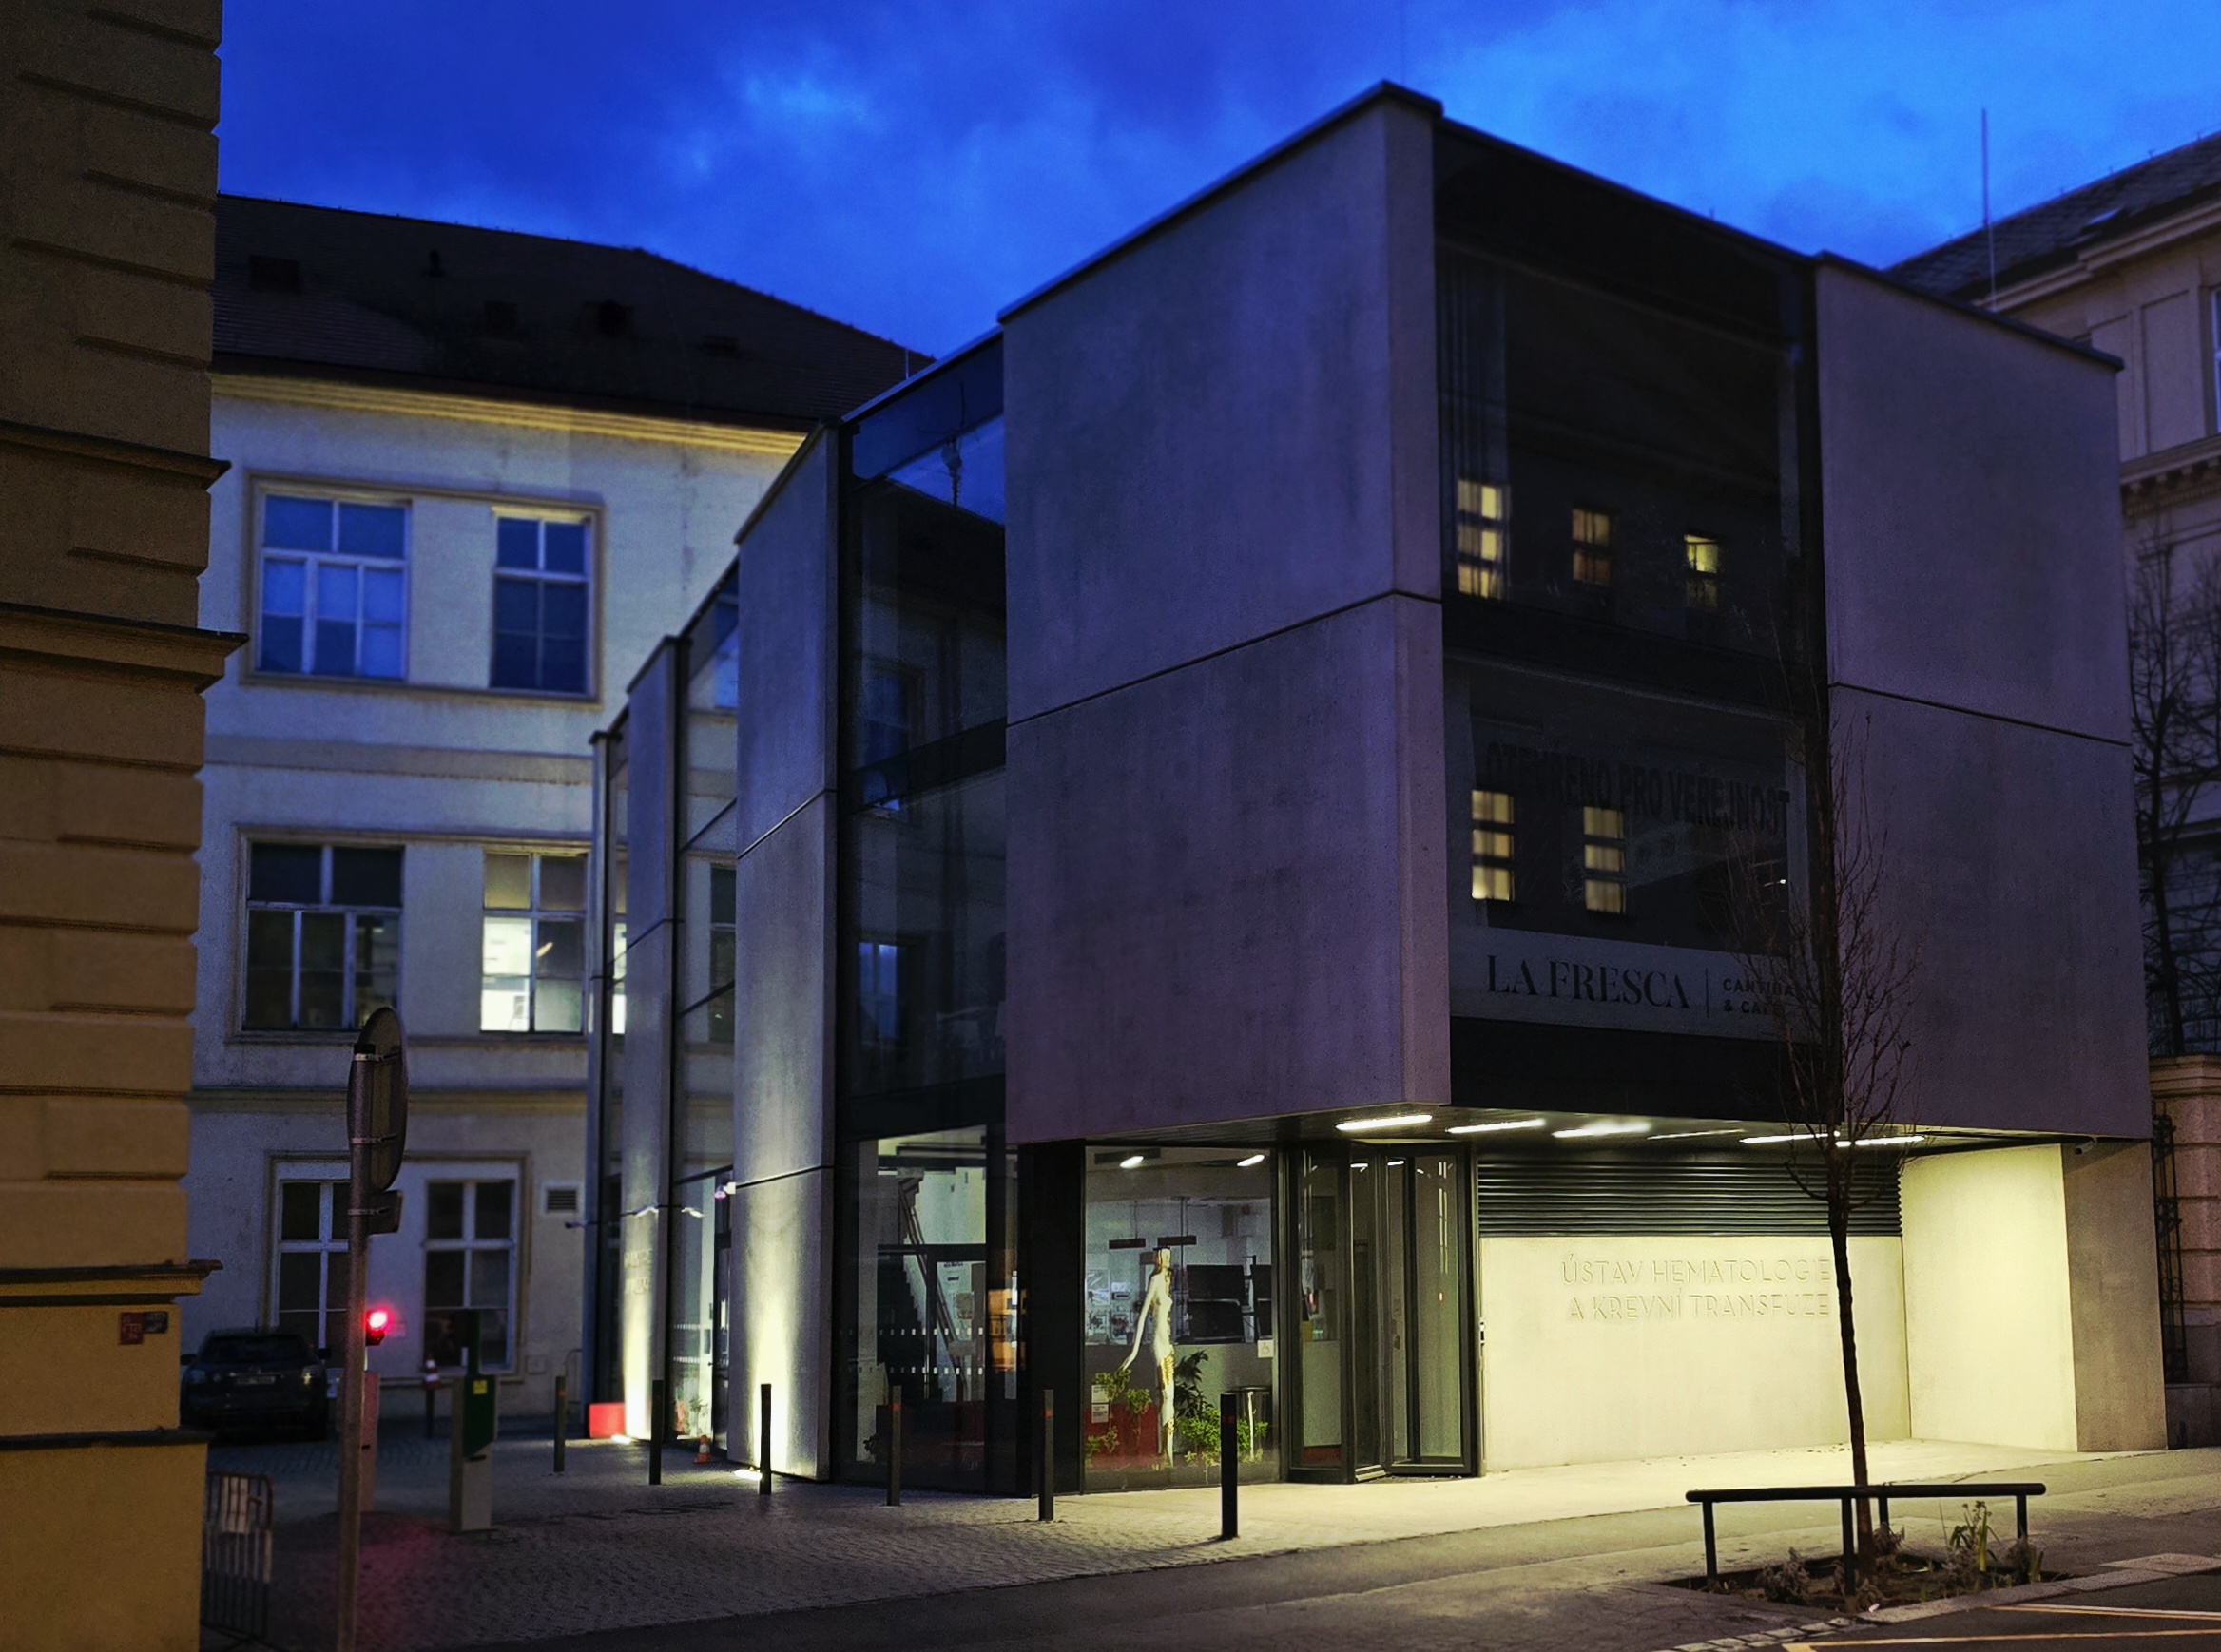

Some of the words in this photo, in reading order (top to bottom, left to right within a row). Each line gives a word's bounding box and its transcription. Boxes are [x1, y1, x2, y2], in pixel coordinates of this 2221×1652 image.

[1618, 761, 1663, 818] PRO
[1487, 954, 1538, 995] LA
[1549, 960, 1690, 1008] FRESCA
[1724, 999, 1733, 1012] &
[1562, 1253, 1643, 1284] ÚSTAV
[1652, 1258, 1831, 1284] HEMATOLOGIE
[1569, 1297, 1584, 1320] A
[1593, 1287, 1682, 1319] KREVNÍ
[1688, 1293, 1829, 1318] TRANSFUZE
